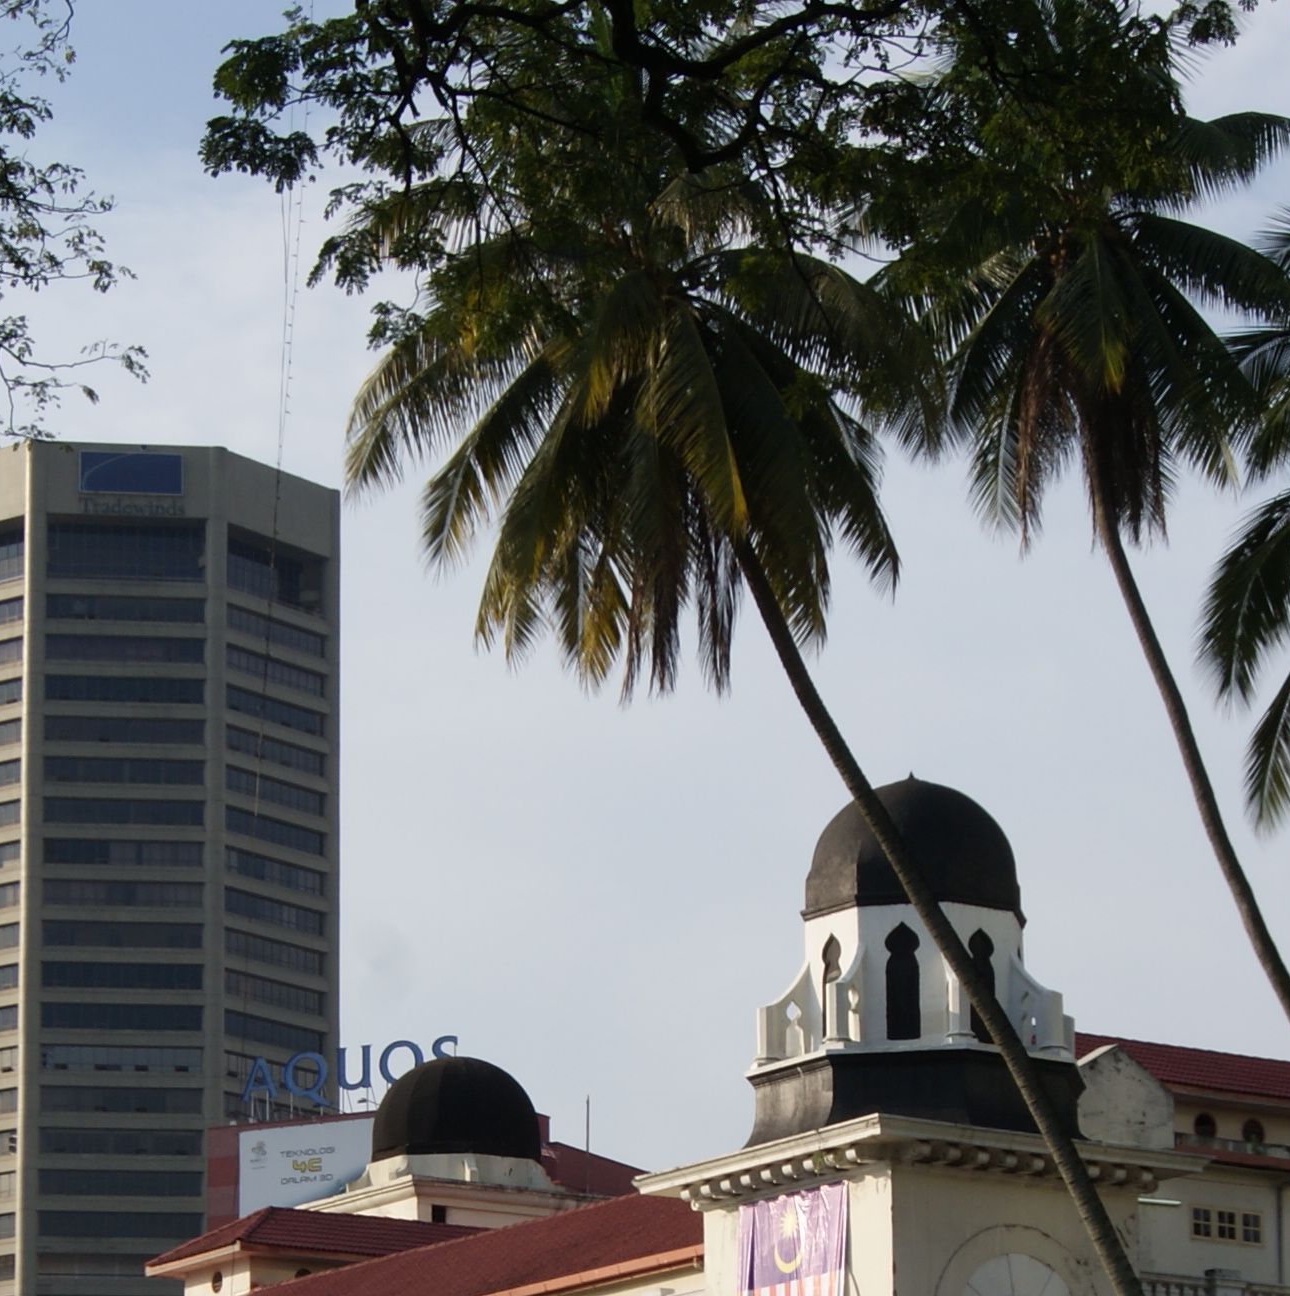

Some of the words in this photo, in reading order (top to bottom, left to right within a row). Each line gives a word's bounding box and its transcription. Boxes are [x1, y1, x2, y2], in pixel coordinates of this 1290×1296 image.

[79, 497, 185, 516] Tradewinds
[280, 1146, 335, 1158] TEKNOLOGI
[291, 1157, 323, 1173] 4C
[280, 1175, 317, 1186] DALAM
